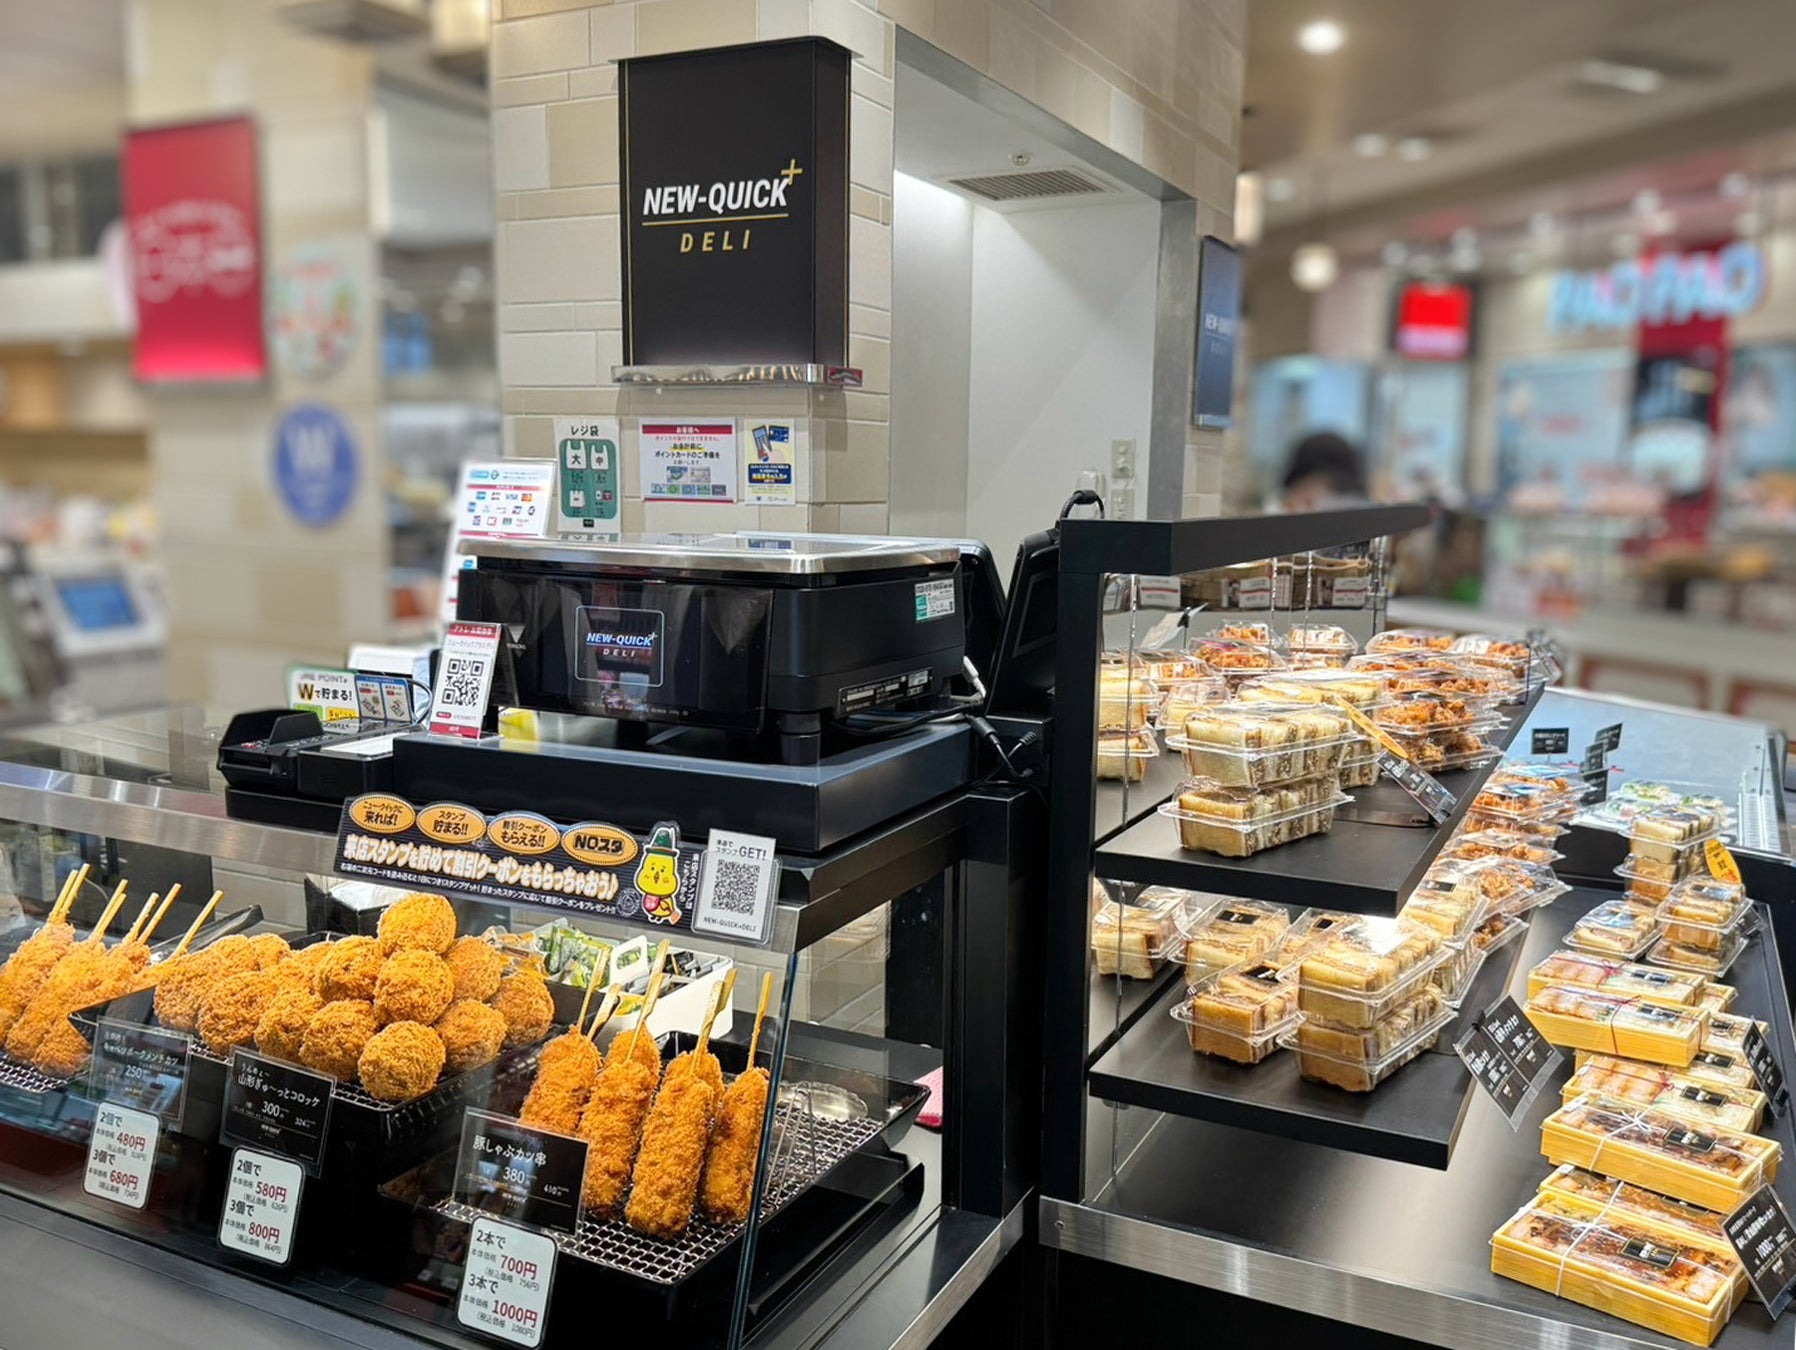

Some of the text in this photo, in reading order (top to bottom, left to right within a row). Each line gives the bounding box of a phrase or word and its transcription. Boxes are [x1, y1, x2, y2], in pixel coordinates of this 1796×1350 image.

[680, 229, 750, 253] DELI
[571, 425, 599, 437] レジ袋
[571, 453, 581, 465] 大
[595, 457, 604, 467] 中
[603, 648, 636, 657] DELI
[364, 811, 398, 826] 来れば!
[439, 810, 467, 821] スタンプ
[503, 820, 548, 833] 割引クーポン
[739, 846, 766, 860] GET!
[100, 1112, 123, 1127] 2個で
[117, 1132, 146, 1151] 480円
[473, 1134, 547, 1166] 豚しゃぶカツ串
[93, 1149, 116, 1165] 3個で
[237, 1159, 261, 1176] 2個で
[109, 1170, 139, 1190] 680円
[255, 1181, 287, 1202] 580円
[229, 1199, 254, 1217] 3個で
[249, 1222, 280, 1244] 800円
[476, 1229, 506, 1249] 2本で
[501, 1254, 537, 1280] 700円
[468, 1273, 499, 1294] 3本で
[492, 1300, 538, 1329] 1000円
